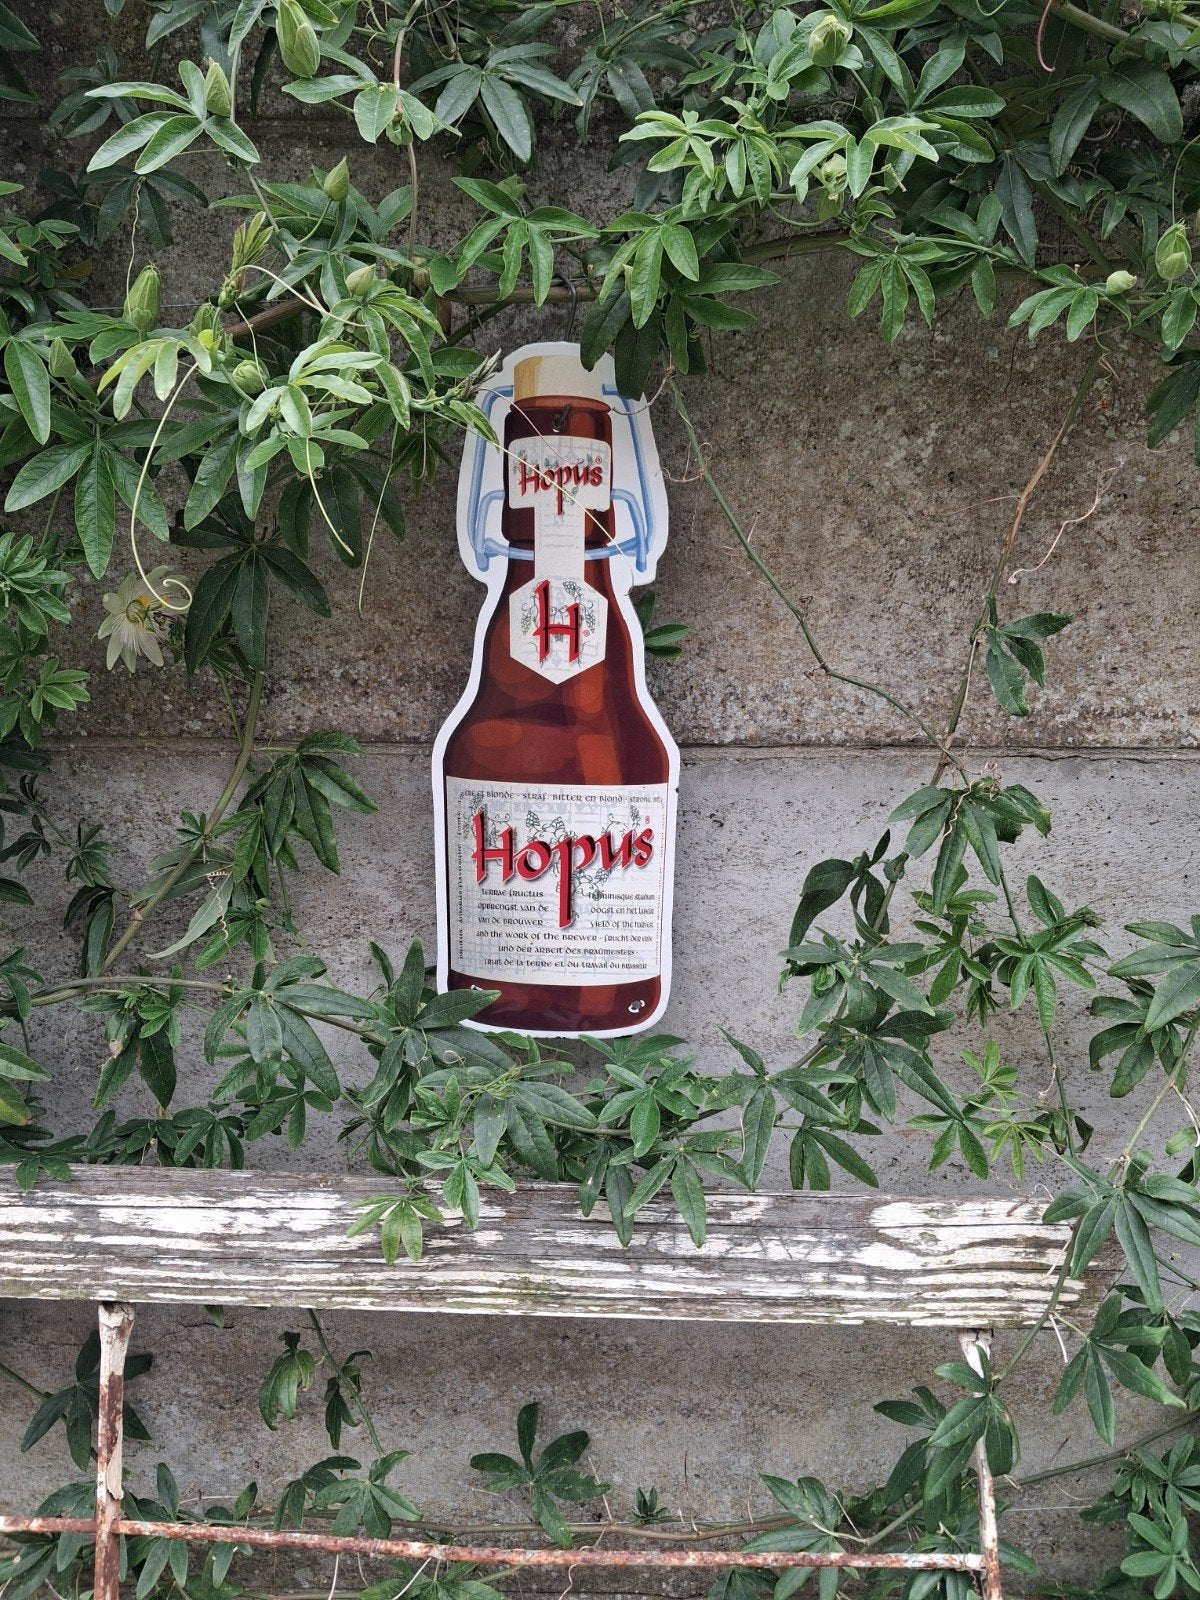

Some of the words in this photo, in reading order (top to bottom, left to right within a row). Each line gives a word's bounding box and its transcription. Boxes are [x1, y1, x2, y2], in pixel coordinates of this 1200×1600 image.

[518, 460, 603, 516] Hopus
[533, 580, 580, 663] H
[471, 810, 655, 928] Hopus
